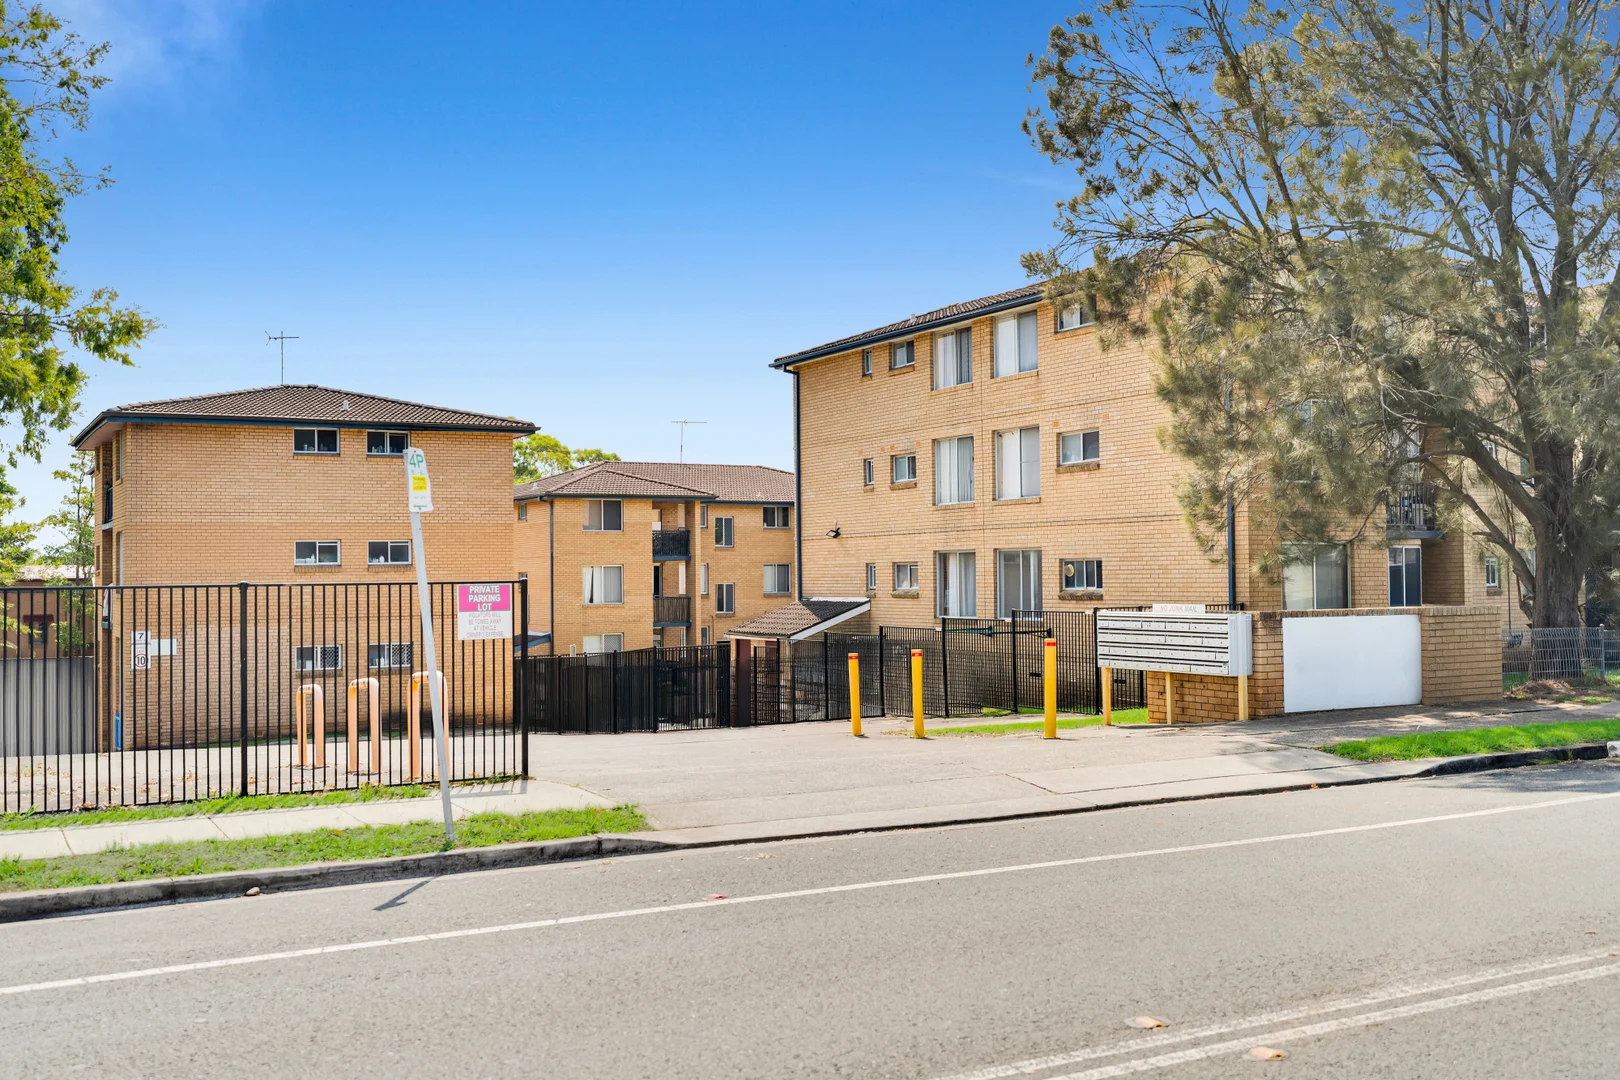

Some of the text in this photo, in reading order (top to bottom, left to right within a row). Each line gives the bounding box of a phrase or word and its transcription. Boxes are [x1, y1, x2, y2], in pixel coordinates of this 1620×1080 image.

[409, 453, 424, 468] 4P
[469, 585, 500, 594] PRIVATE
[468, 594, 501, 602] PARKING
[477, 603, 492, 611] LOT
[137, 656, 146, 665] 10
